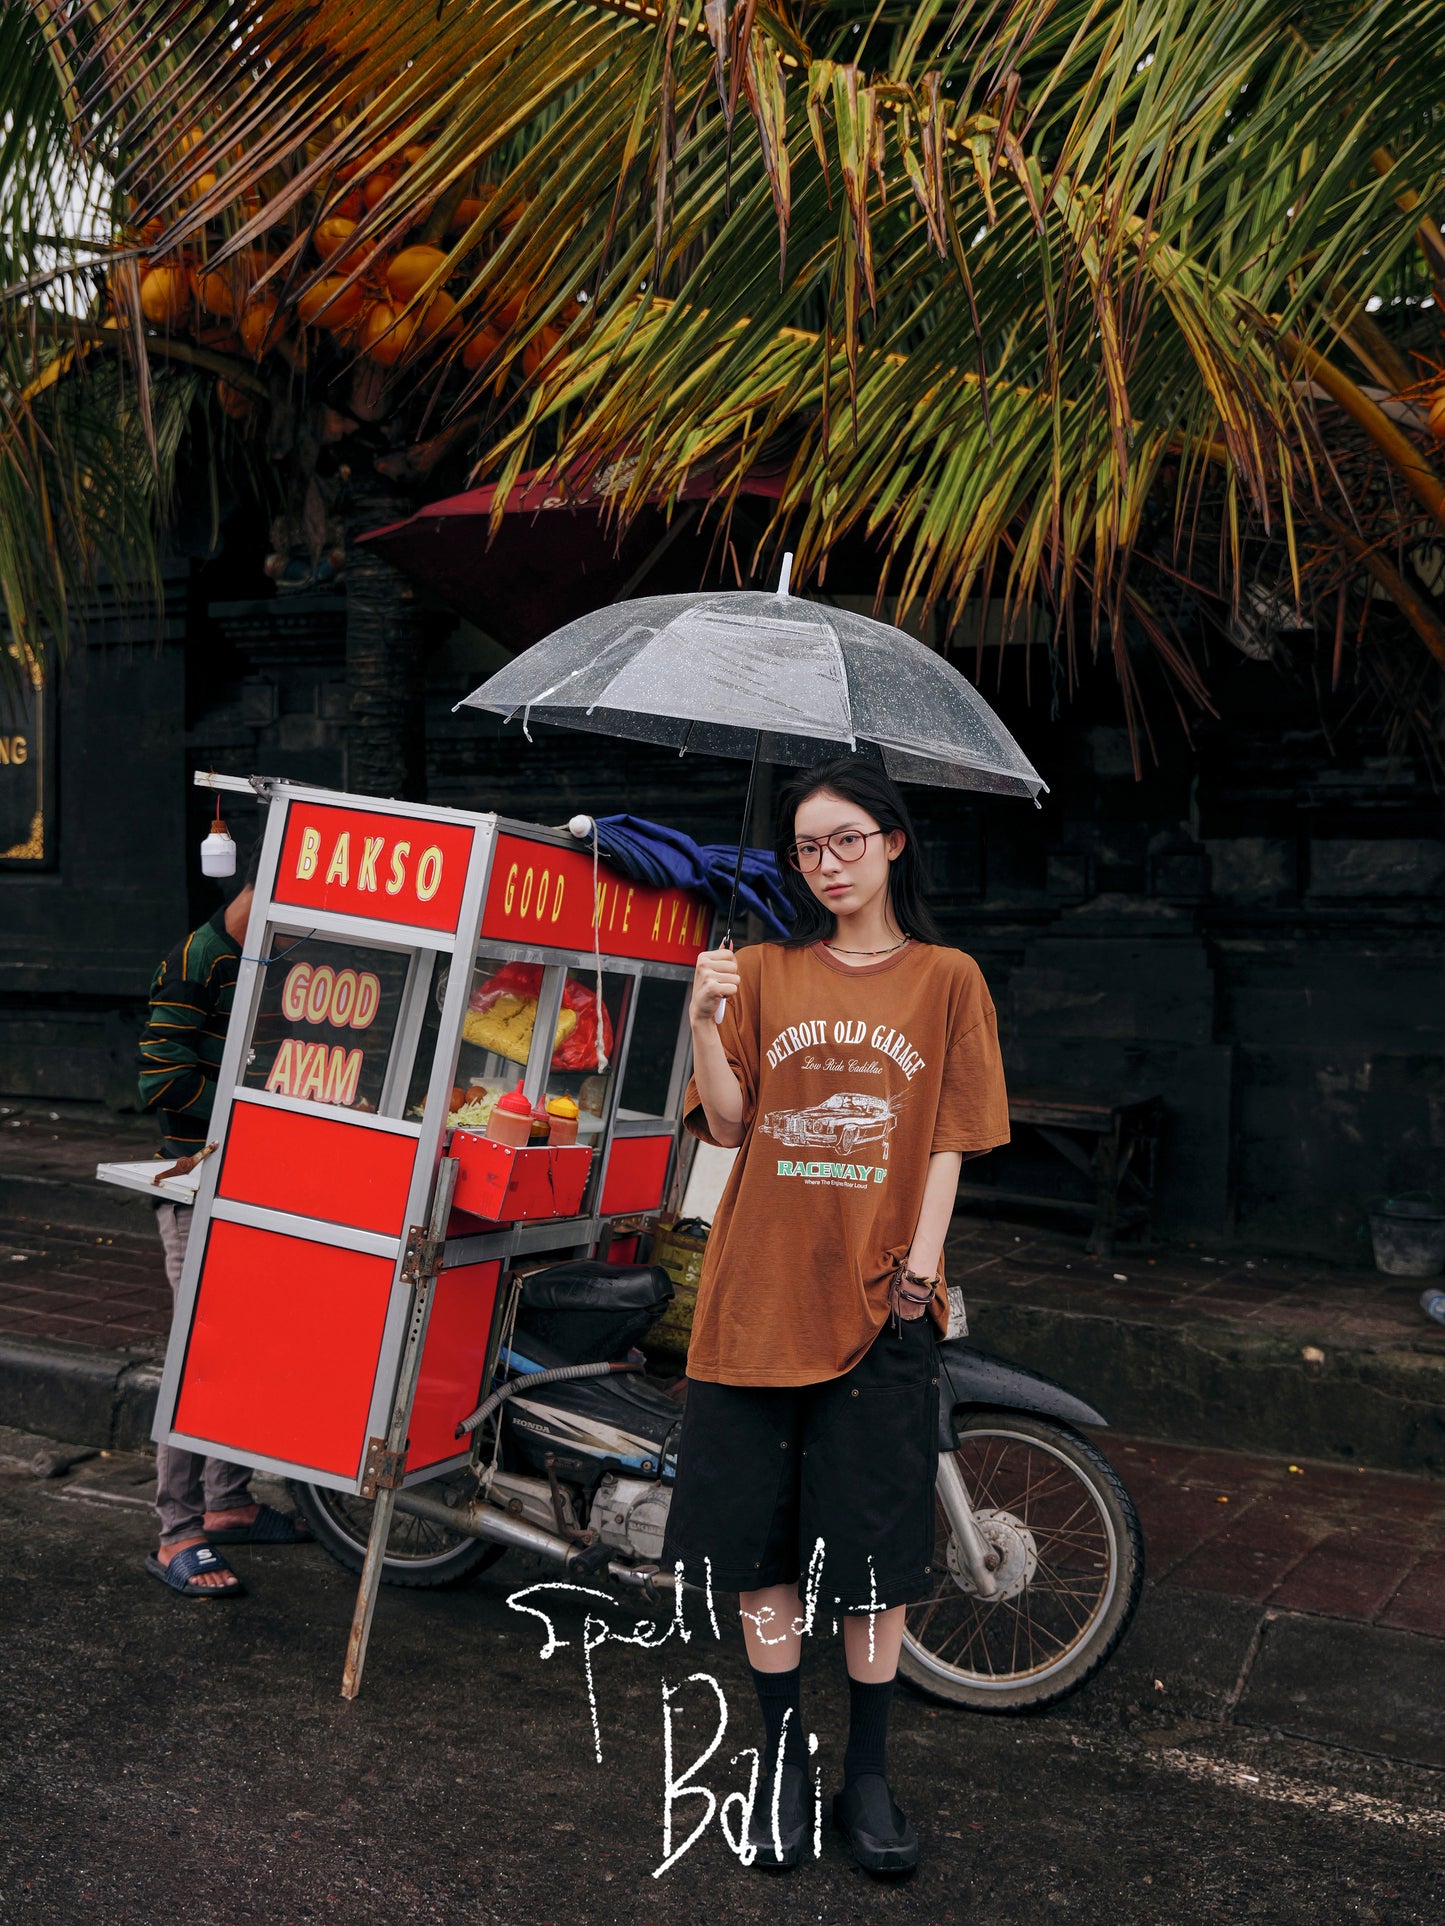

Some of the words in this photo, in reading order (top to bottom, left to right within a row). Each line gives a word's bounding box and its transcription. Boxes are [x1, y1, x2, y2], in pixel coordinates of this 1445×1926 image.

[296, 827, 443, 901] BAKSO
[504, 863, 565, 922] GOOD
[591, 881, 634, 933] MIE
[282, 962, 380, 1029] GOOD
[265, 1039, 363, 1106] AYAM
[766, 1020, 827, 1070] DETROIT
[833, 1021, 867, 1044] OLD
[871, 1025, 926, 1081] GARAGE
[802, 1056, 822, 1070] Low
[823, 1058, 845, 1072] Ride
[848, 1060, 883, 1075] Cadillac
[777, 1160, 875, 1182] RACEWAY
[512, 1417, 551, 1433] HONDA
